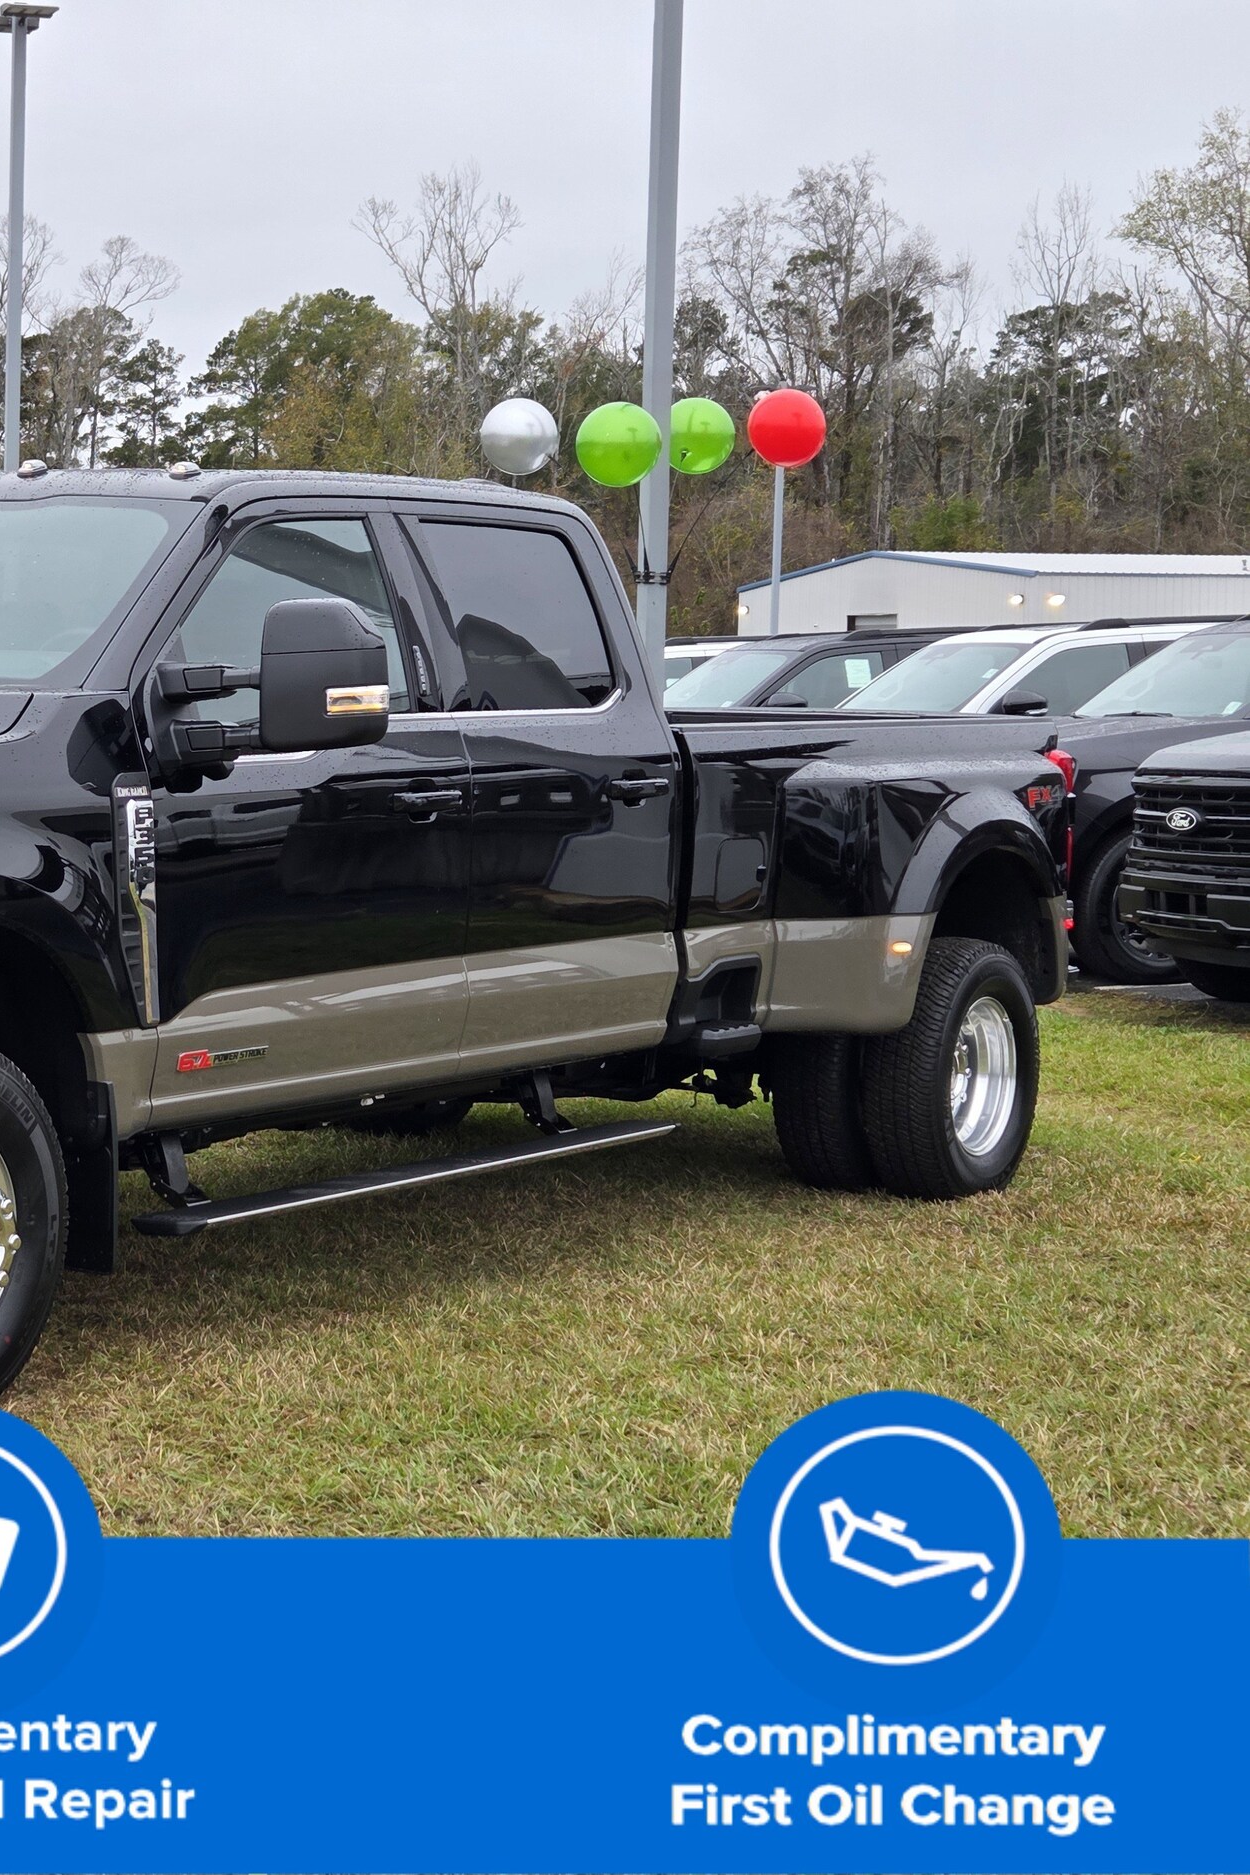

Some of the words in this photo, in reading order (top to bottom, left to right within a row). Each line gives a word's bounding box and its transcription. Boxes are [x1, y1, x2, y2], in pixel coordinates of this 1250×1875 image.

[1171, 812, 1191, 828] Ford
[213, 1052, 238, 1064] POWER
[238, 1047, 268, 1060] STROKE
